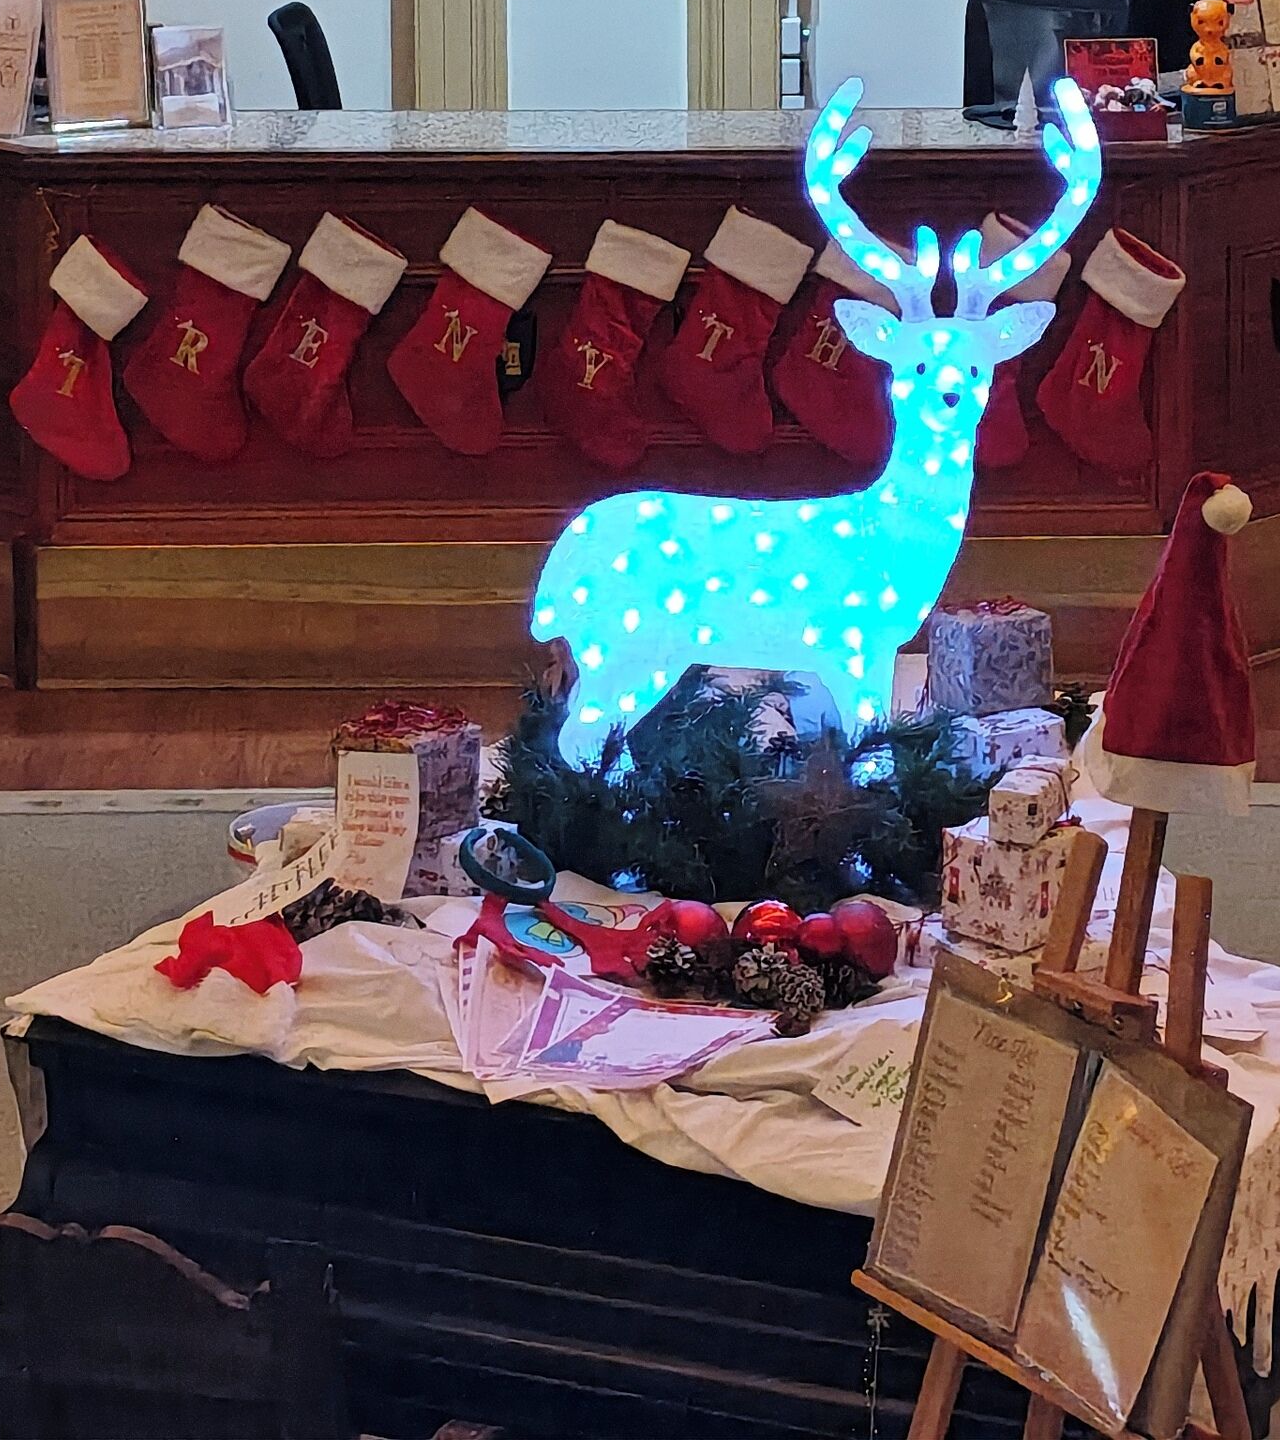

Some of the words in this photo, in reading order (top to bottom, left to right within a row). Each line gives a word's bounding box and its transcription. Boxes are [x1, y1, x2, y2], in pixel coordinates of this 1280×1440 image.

[169, 319, 209, 375] R
[289, 318, 329, 369] E
[434, 309, 479, 362] N
[577, 340, 613, 390] Y
[696, 312, 735, 362] T
[804, 317, 848, 371] H
[1078, 342, 1123, 394] N
